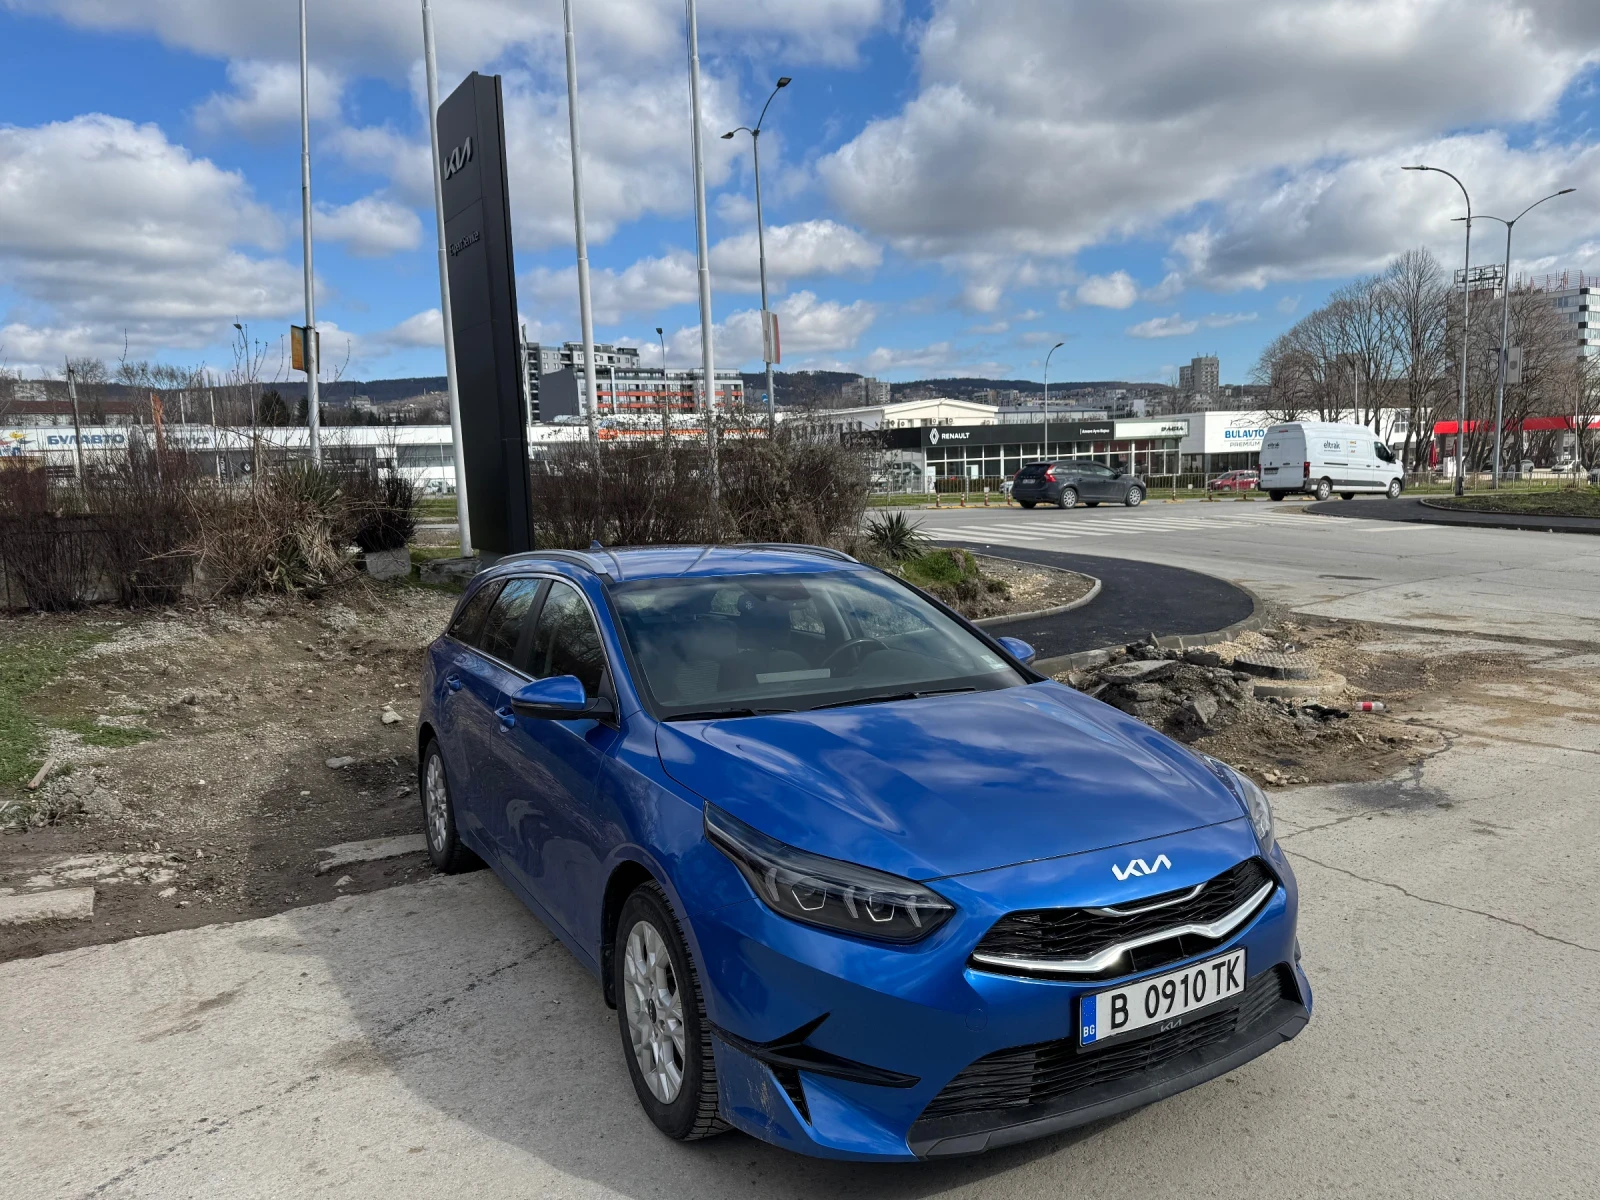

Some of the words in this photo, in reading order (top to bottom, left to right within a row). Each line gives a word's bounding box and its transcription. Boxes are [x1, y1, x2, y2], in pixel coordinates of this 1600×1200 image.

[443, 136, 473, 180] KIA
[47, 433, 125, 445] БУЛАВТО
[941, 432, 970, 440] RENAULT
[1225, 429, 1265, 439] BULAVTO
[1324, 440, 1340, 449] eltrak
[1111, 854, 1172, 881] KIA
[1110, 993, 1129, 1030] B
[1144, 969, 1207, 1019] 0910
[1212, 956, 1241, 996] TK
[1083, 1024, 1096, 1038] BG
[1160, 1018, 1183, 1033] KIA
